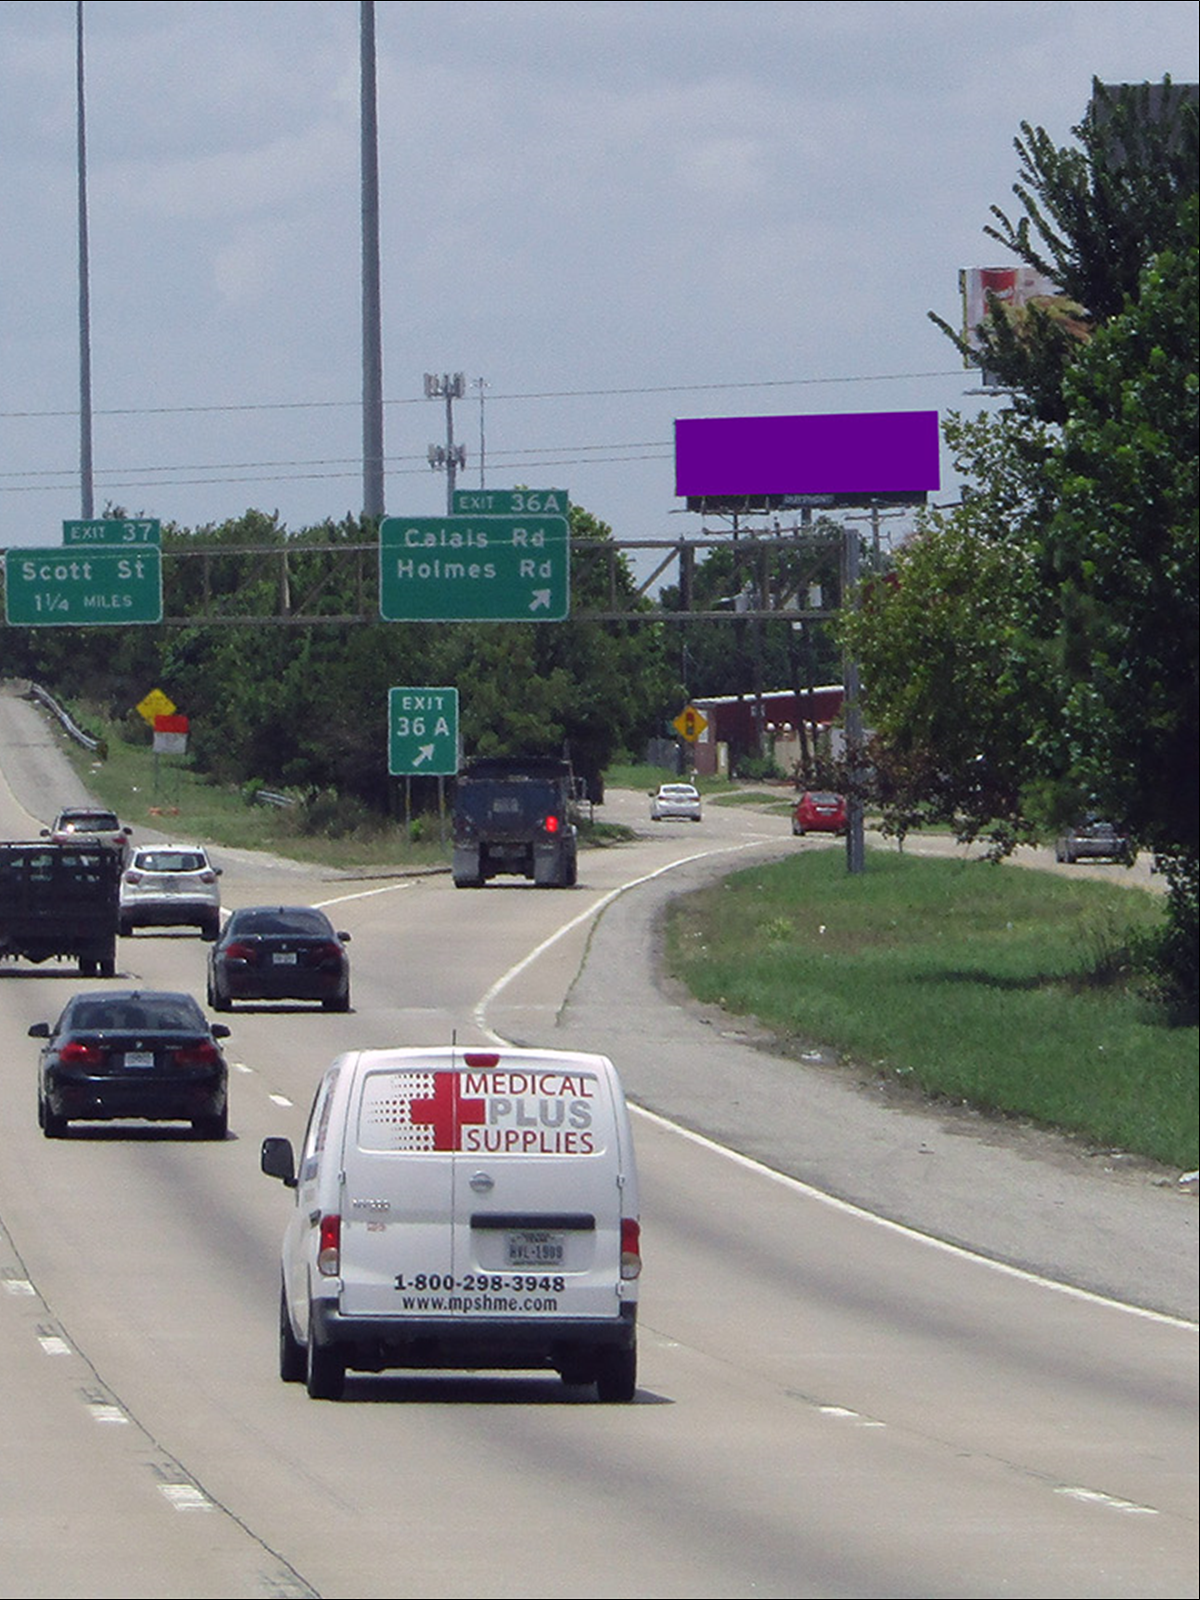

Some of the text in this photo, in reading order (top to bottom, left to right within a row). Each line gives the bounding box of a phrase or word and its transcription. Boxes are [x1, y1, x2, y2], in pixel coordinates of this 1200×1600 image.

[459, 493, 560, 512] EXIT 36A
[71, 523, 152, 542] EXIT 37
[404, 528, 545, 548] Calais Rd
[22, 559, 144, 580] Scott St
[397, 559, 552, 578] Holmes Rd
[84, 594, 133, 608] MILES
[402, 696, 444, 710] EXIT
[397, 716, 450, 736] 36 A
[465, 1073, 593, 1098] MEDICAL
[489, 1098, 592, 1129] PLUS
[467, 1129, 594, 1154] SUPPLIES
[394, 1273, 565, 1292] 1-800-298-3948
[402, 1294, 558, 1313] www.mpshme.com
